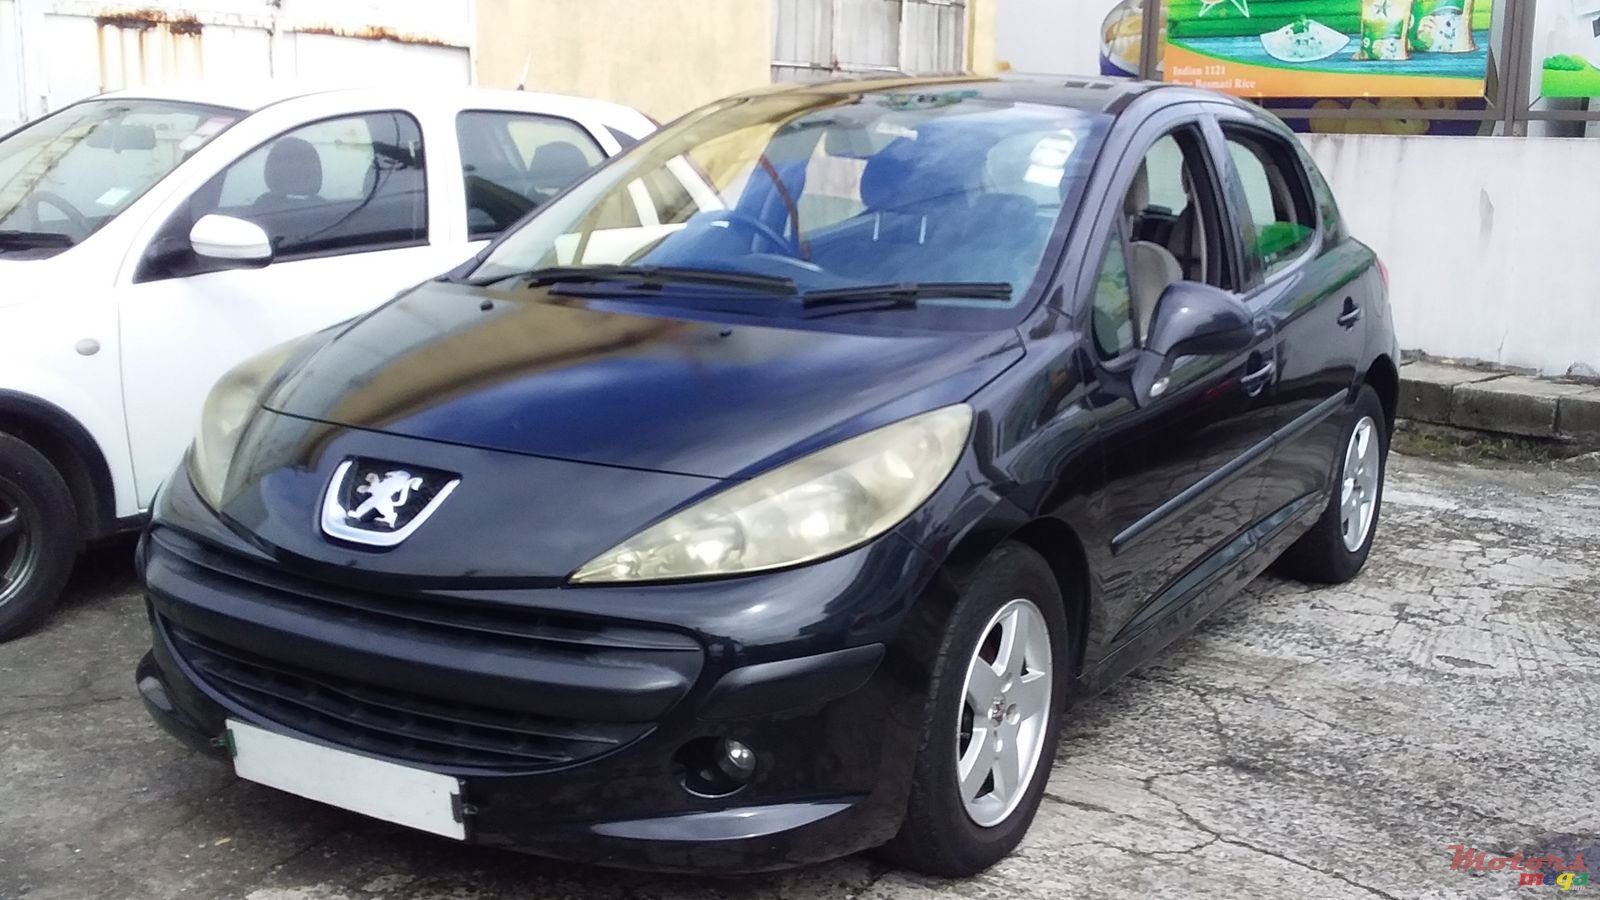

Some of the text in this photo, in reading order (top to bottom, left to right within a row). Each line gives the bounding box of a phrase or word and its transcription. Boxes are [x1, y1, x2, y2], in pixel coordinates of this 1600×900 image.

[1173, 65, 1225, 75] Indian 1121
[1234, 79, 1256, 88] Rice
